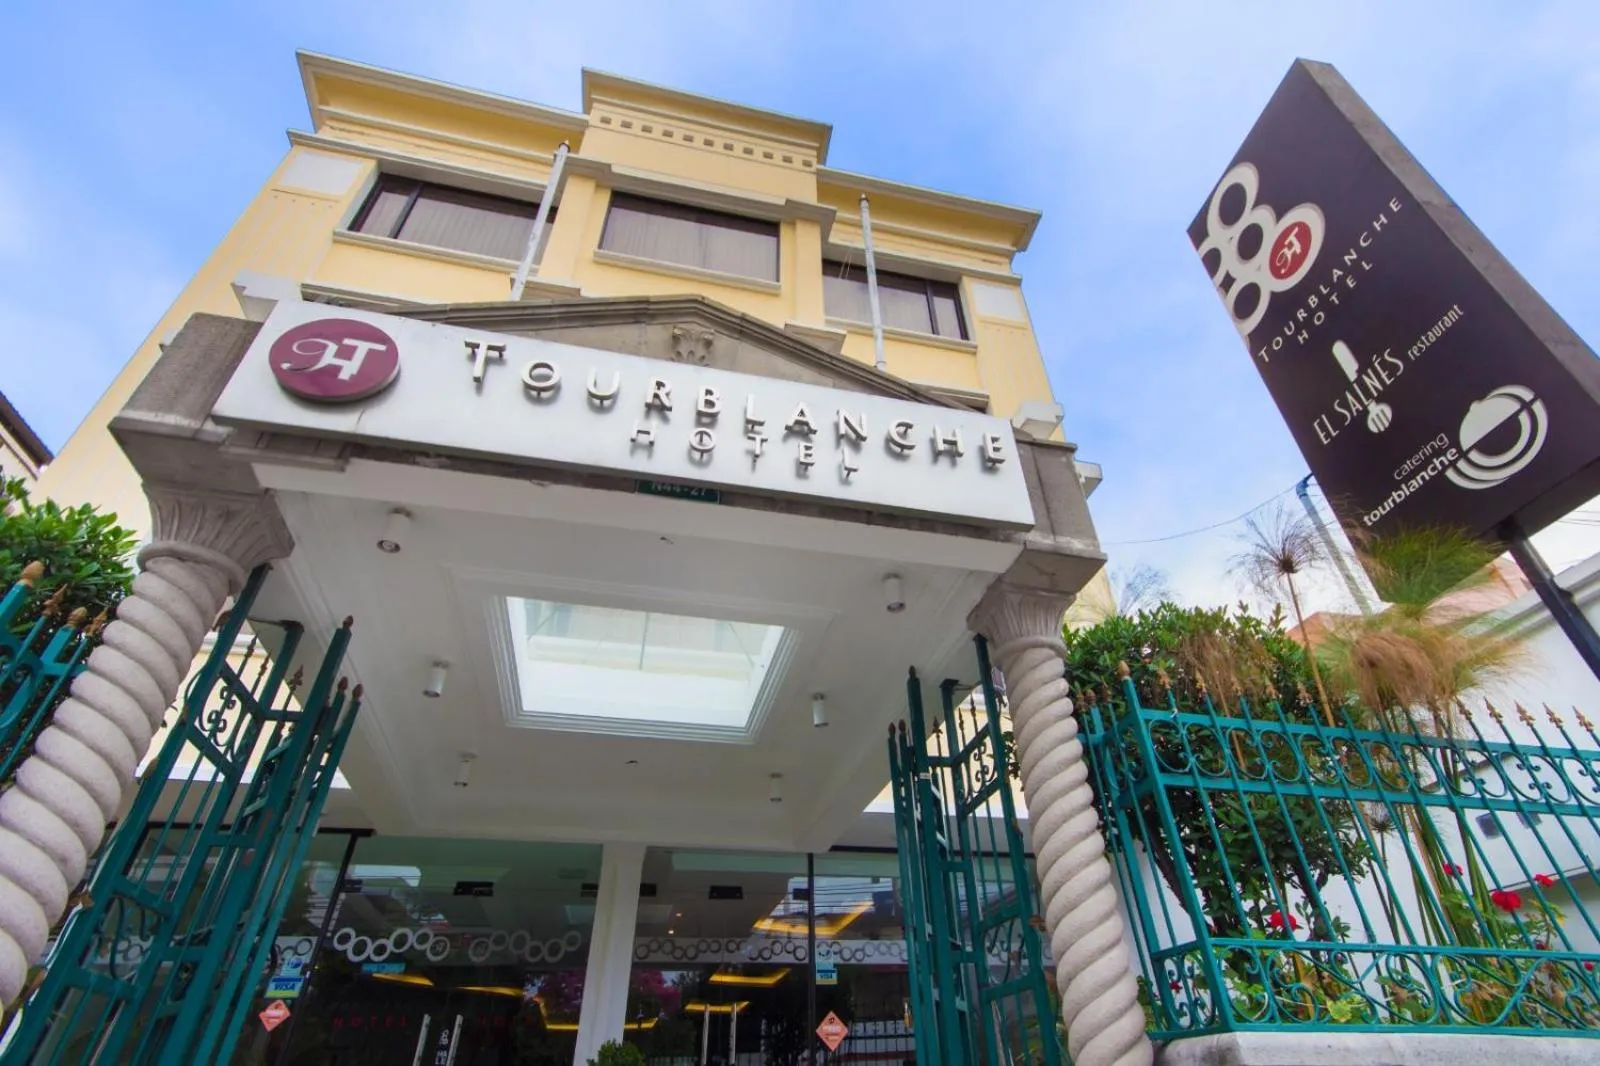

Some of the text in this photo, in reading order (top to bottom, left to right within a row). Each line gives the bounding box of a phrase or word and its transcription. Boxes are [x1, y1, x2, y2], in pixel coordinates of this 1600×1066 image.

[1258, 197, 1402, 363] TOURBLANCHE
[1297, 260, 1373, 345] HOTEL
[464, 339, 1006, 464] TOURBLANCHE
[1313, 303, 1464, 445] EL SALNÉS restaurant
[629, 420, 859, 475] HOTEL
[1363, 447, 1460, 527] tourblanche
[1394, 431, 1449, 480] catering
